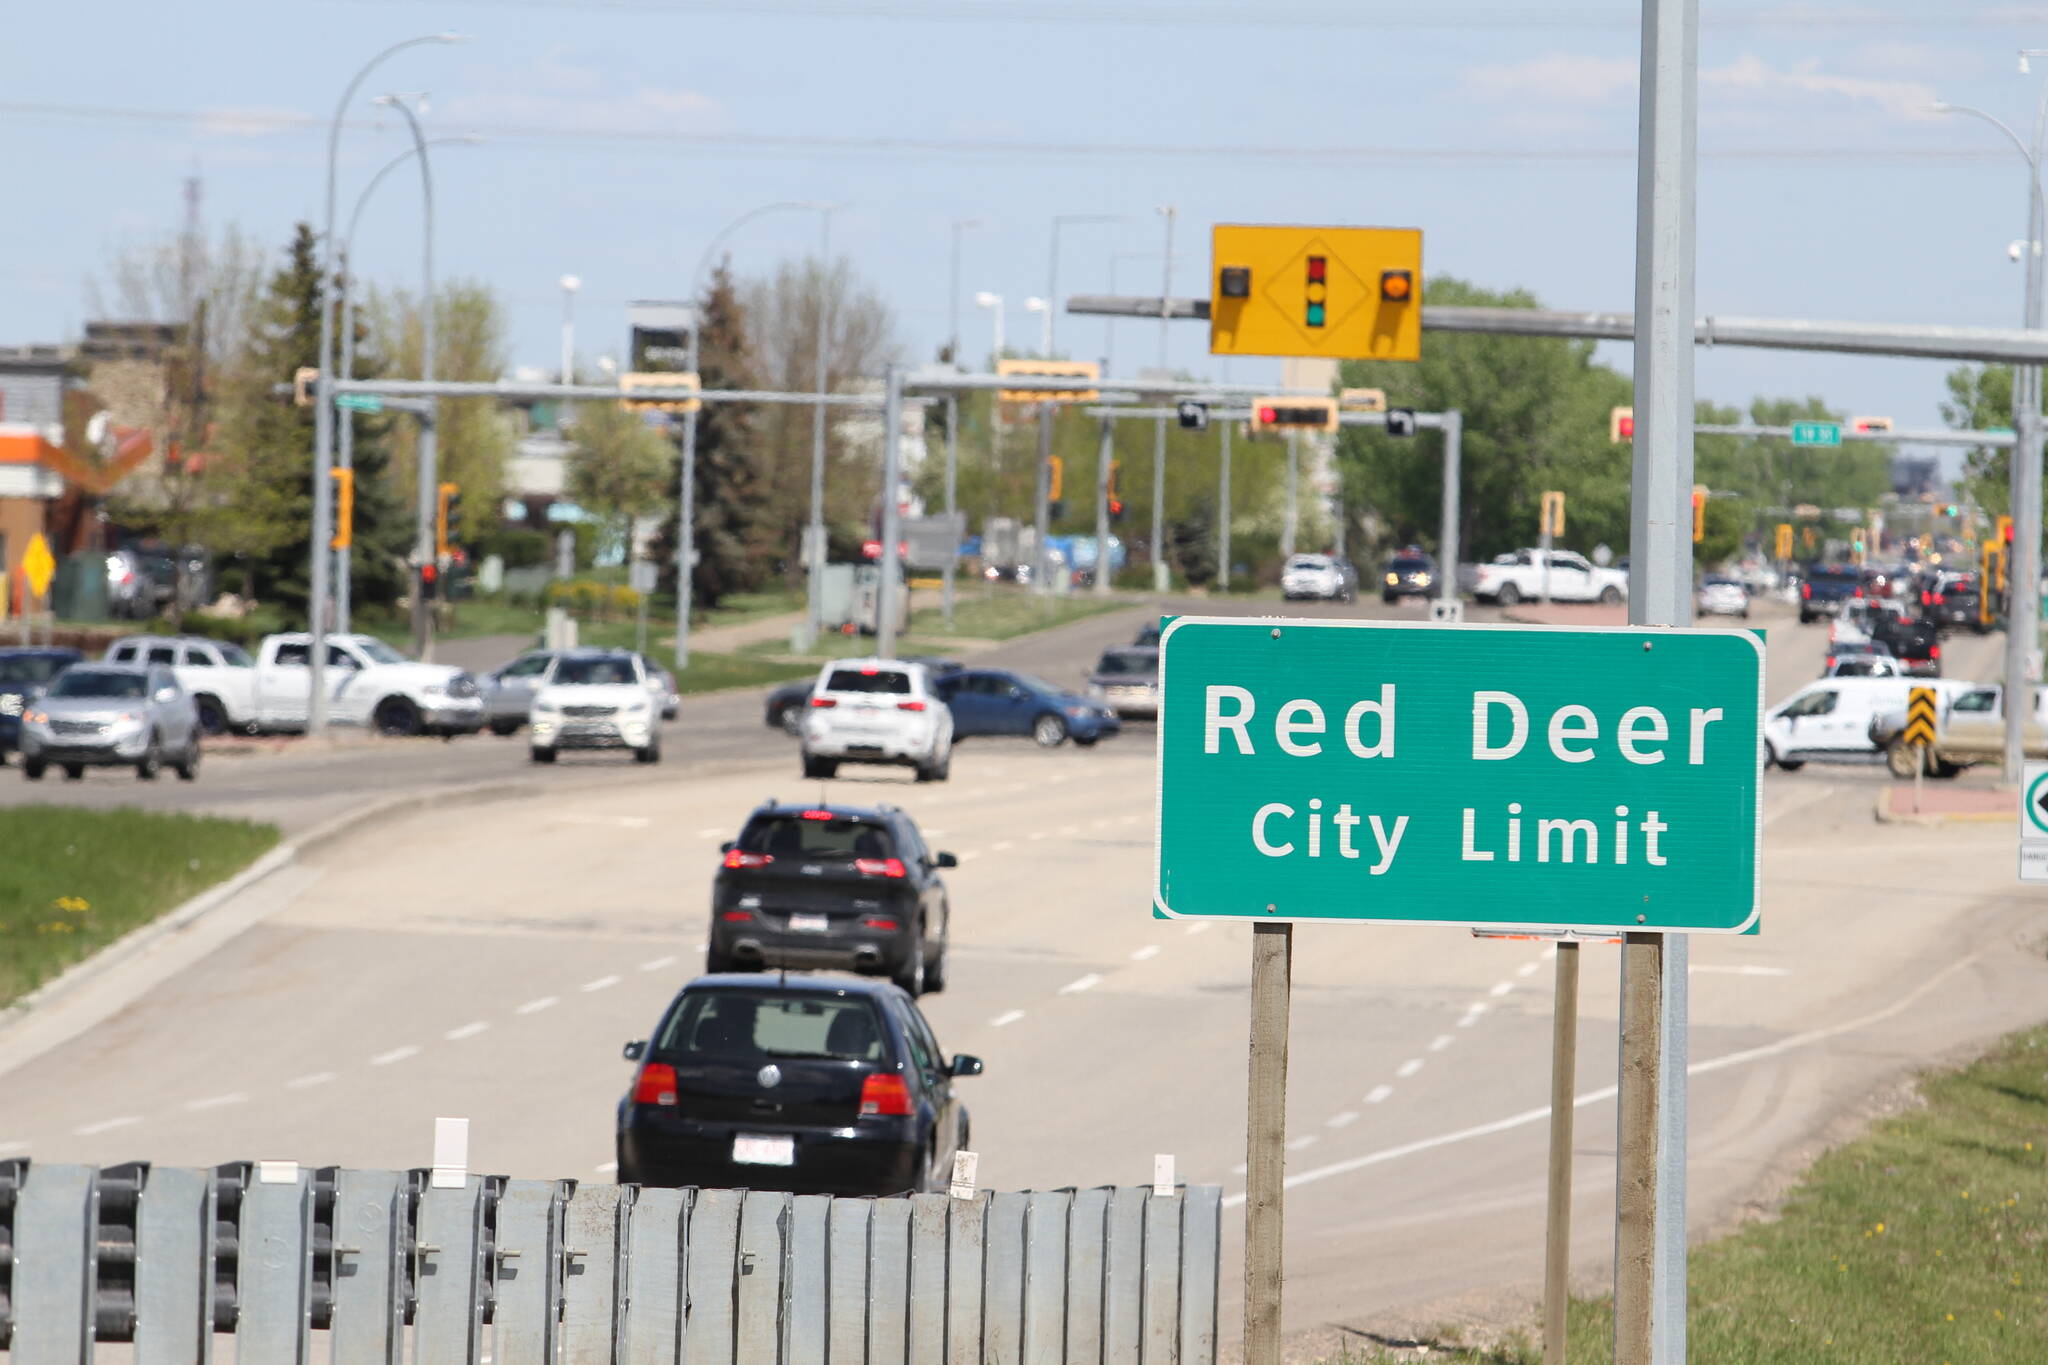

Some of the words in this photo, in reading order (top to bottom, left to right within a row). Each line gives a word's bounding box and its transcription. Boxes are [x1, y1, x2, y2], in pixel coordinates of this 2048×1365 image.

[1204, 683, 1396, 759] Red
[1471, 690, 1724, 765] Deer
[1251, 798, 1410, 876] City
[1461, 802, 1669, 866] Limit
